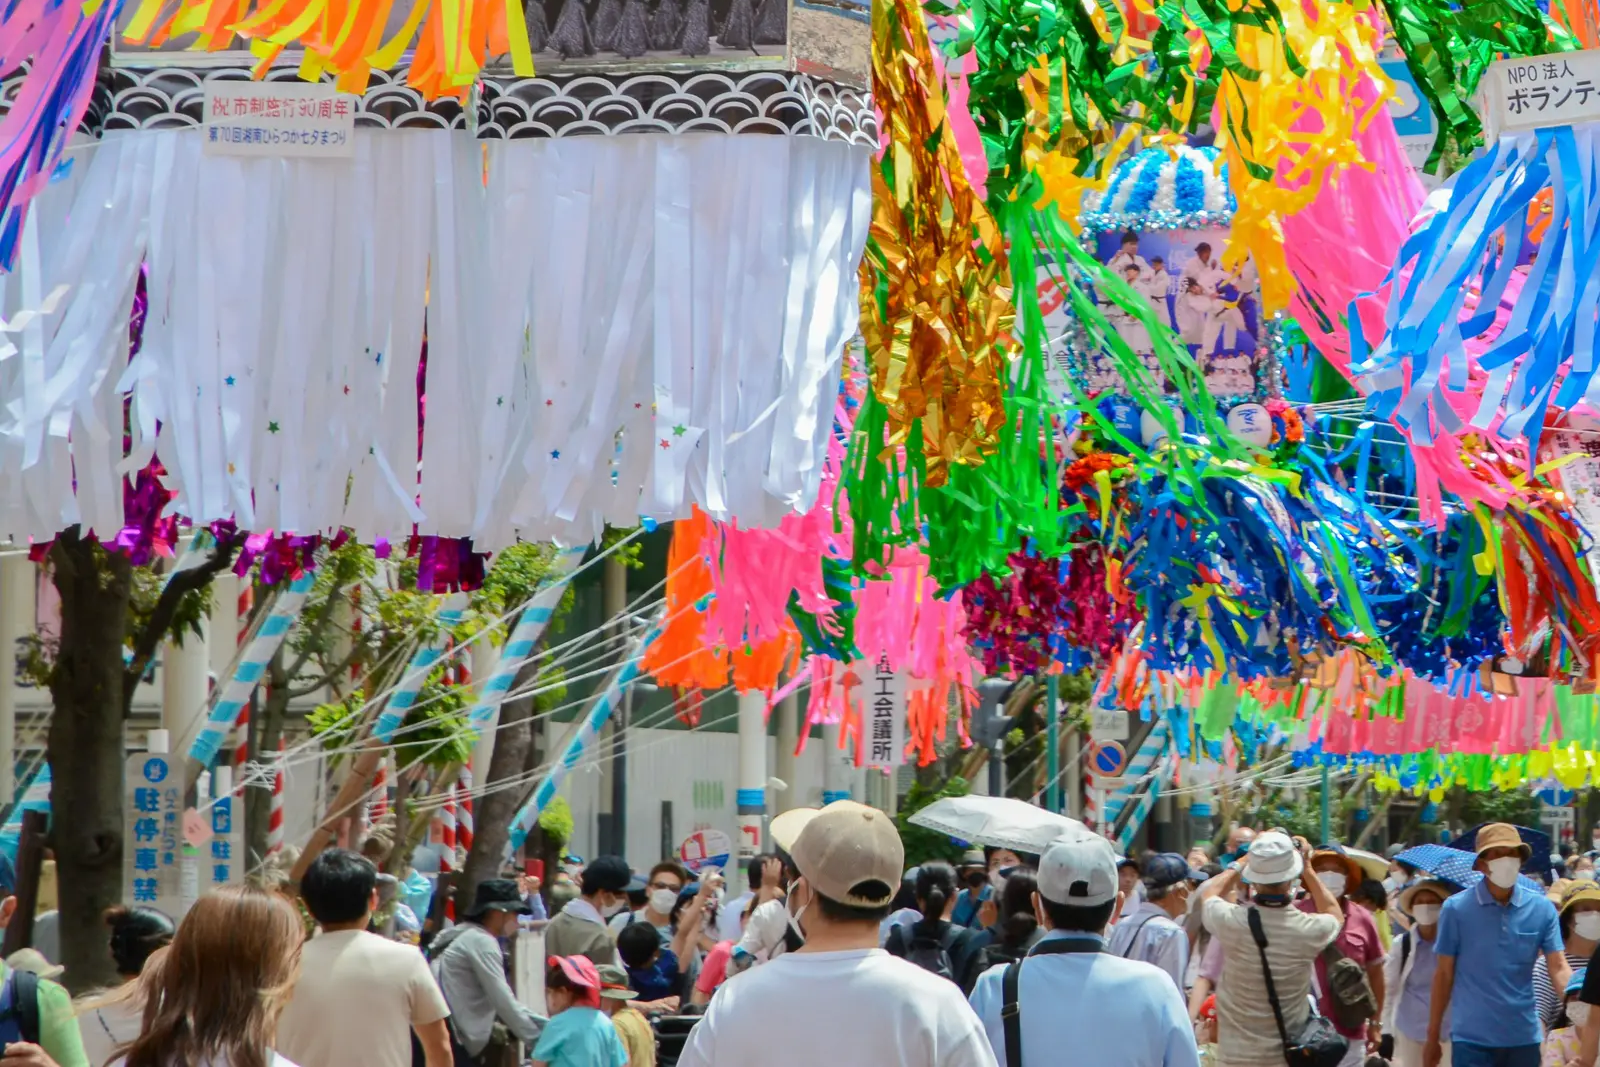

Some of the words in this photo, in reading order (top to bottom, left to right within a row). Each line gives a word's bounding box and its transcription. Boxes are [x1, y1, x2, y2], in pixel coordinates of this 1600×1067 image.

[208, 126, 347, 146] 第70回湘南ひらつか七夕まつり
